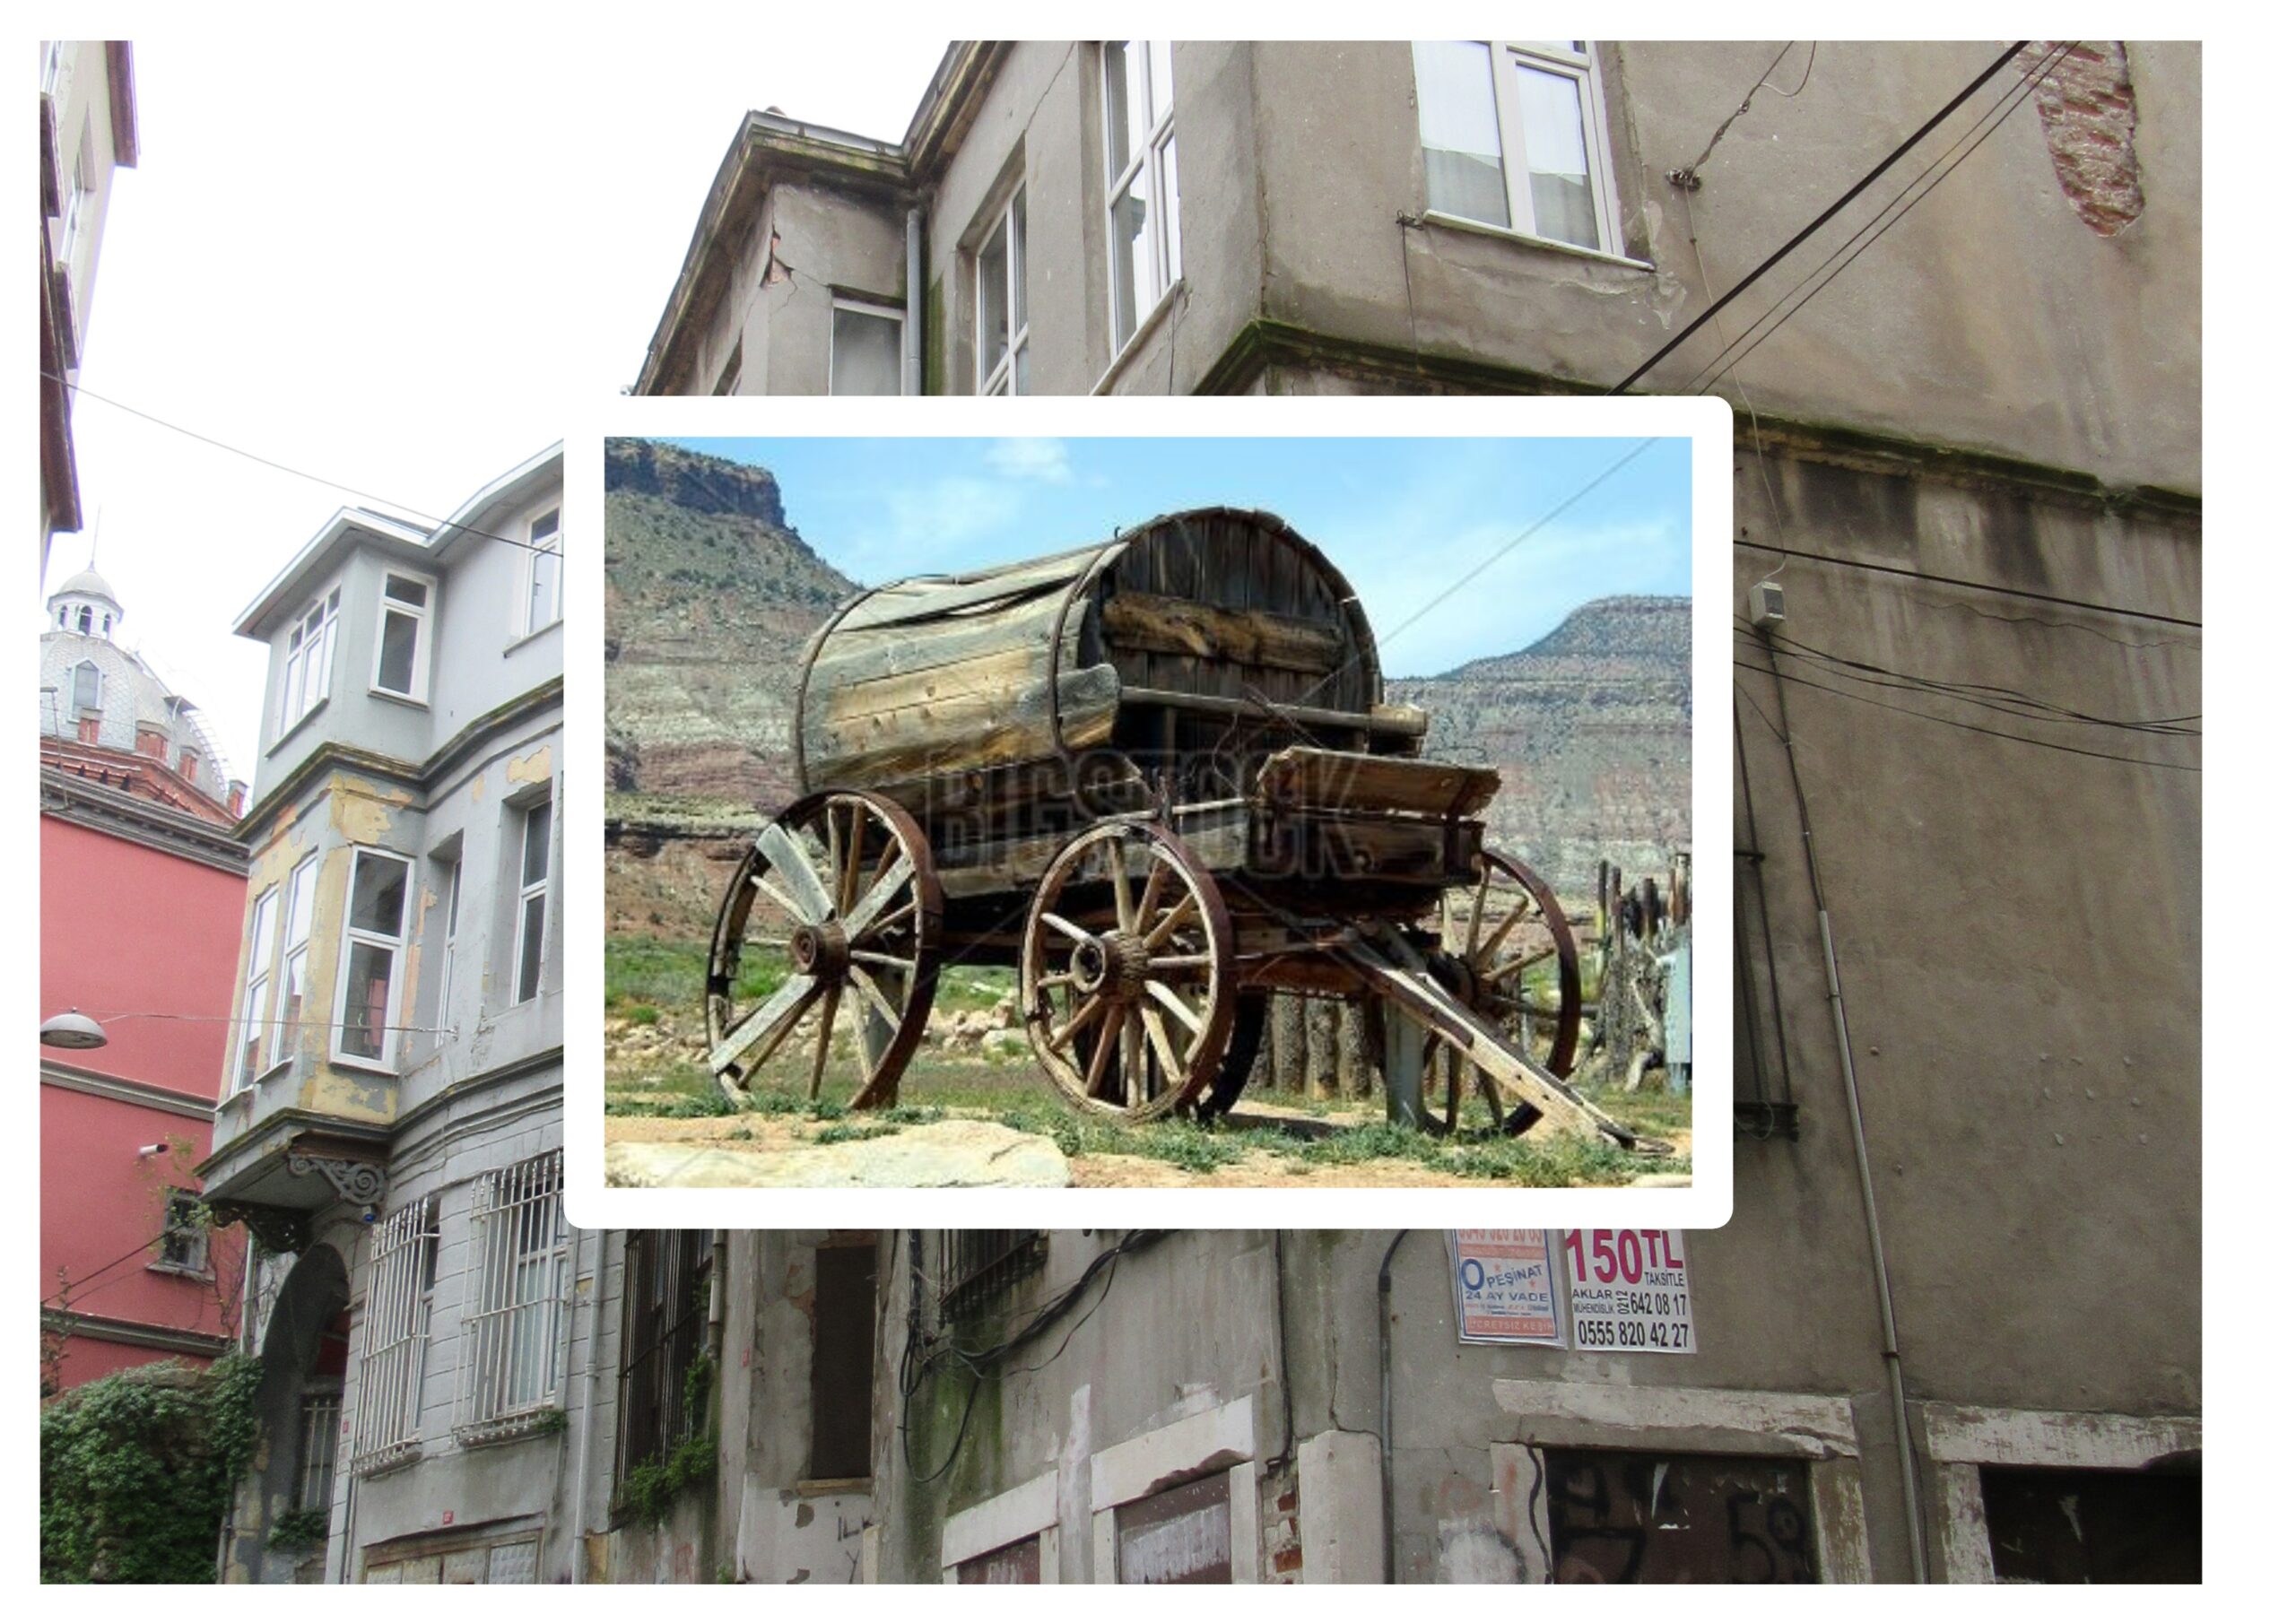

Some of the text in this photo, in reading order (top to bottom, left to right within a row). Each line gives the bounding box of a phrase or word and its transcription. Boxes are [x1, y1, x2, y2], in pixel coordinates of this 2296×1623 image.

[1486, 1264, 1543, 1288] PEŞİNAT
[1645, 1270, 1684, 1287] TAKSİTLE
[1465, 1291, 1550, 1302] 24 AY VADE
[1572, 1289, 1686, 1316] AKLAR 0212 642 08 17
[1578, 1320, 1688, 1348] 0555 820 42 27
